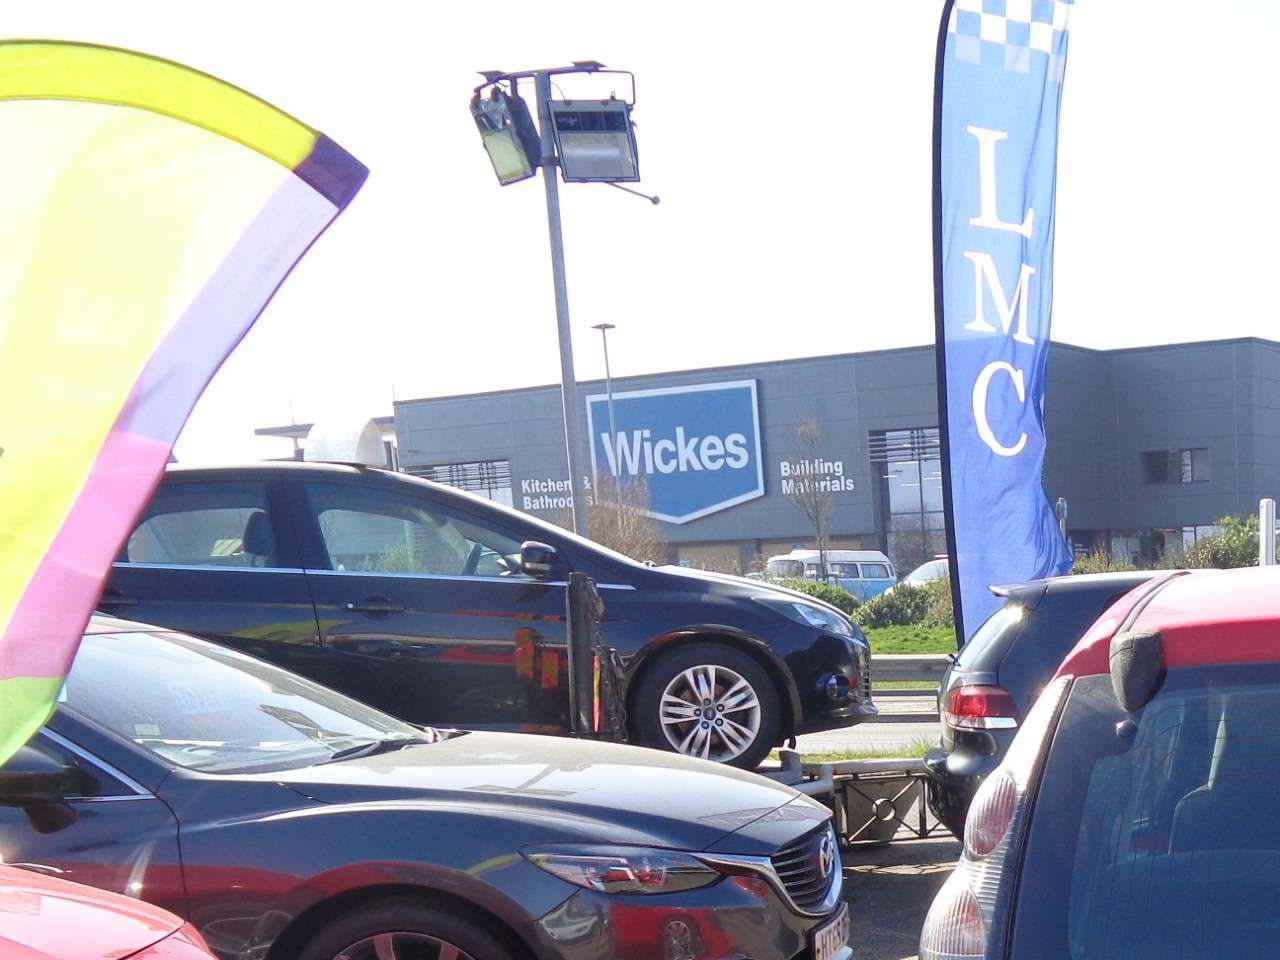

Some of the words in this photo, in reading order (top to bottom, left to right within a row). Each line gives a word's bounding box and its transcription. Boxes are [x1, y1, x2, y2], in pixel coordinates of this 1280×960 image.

[600, 426, 749, 476] Wickes
[780, 458, 843, 476] Building
[521, 478, 572, 494] Kitchen
[781, 475, 855, 495] Materials
[523, 495, 594, 510] Bathroos
